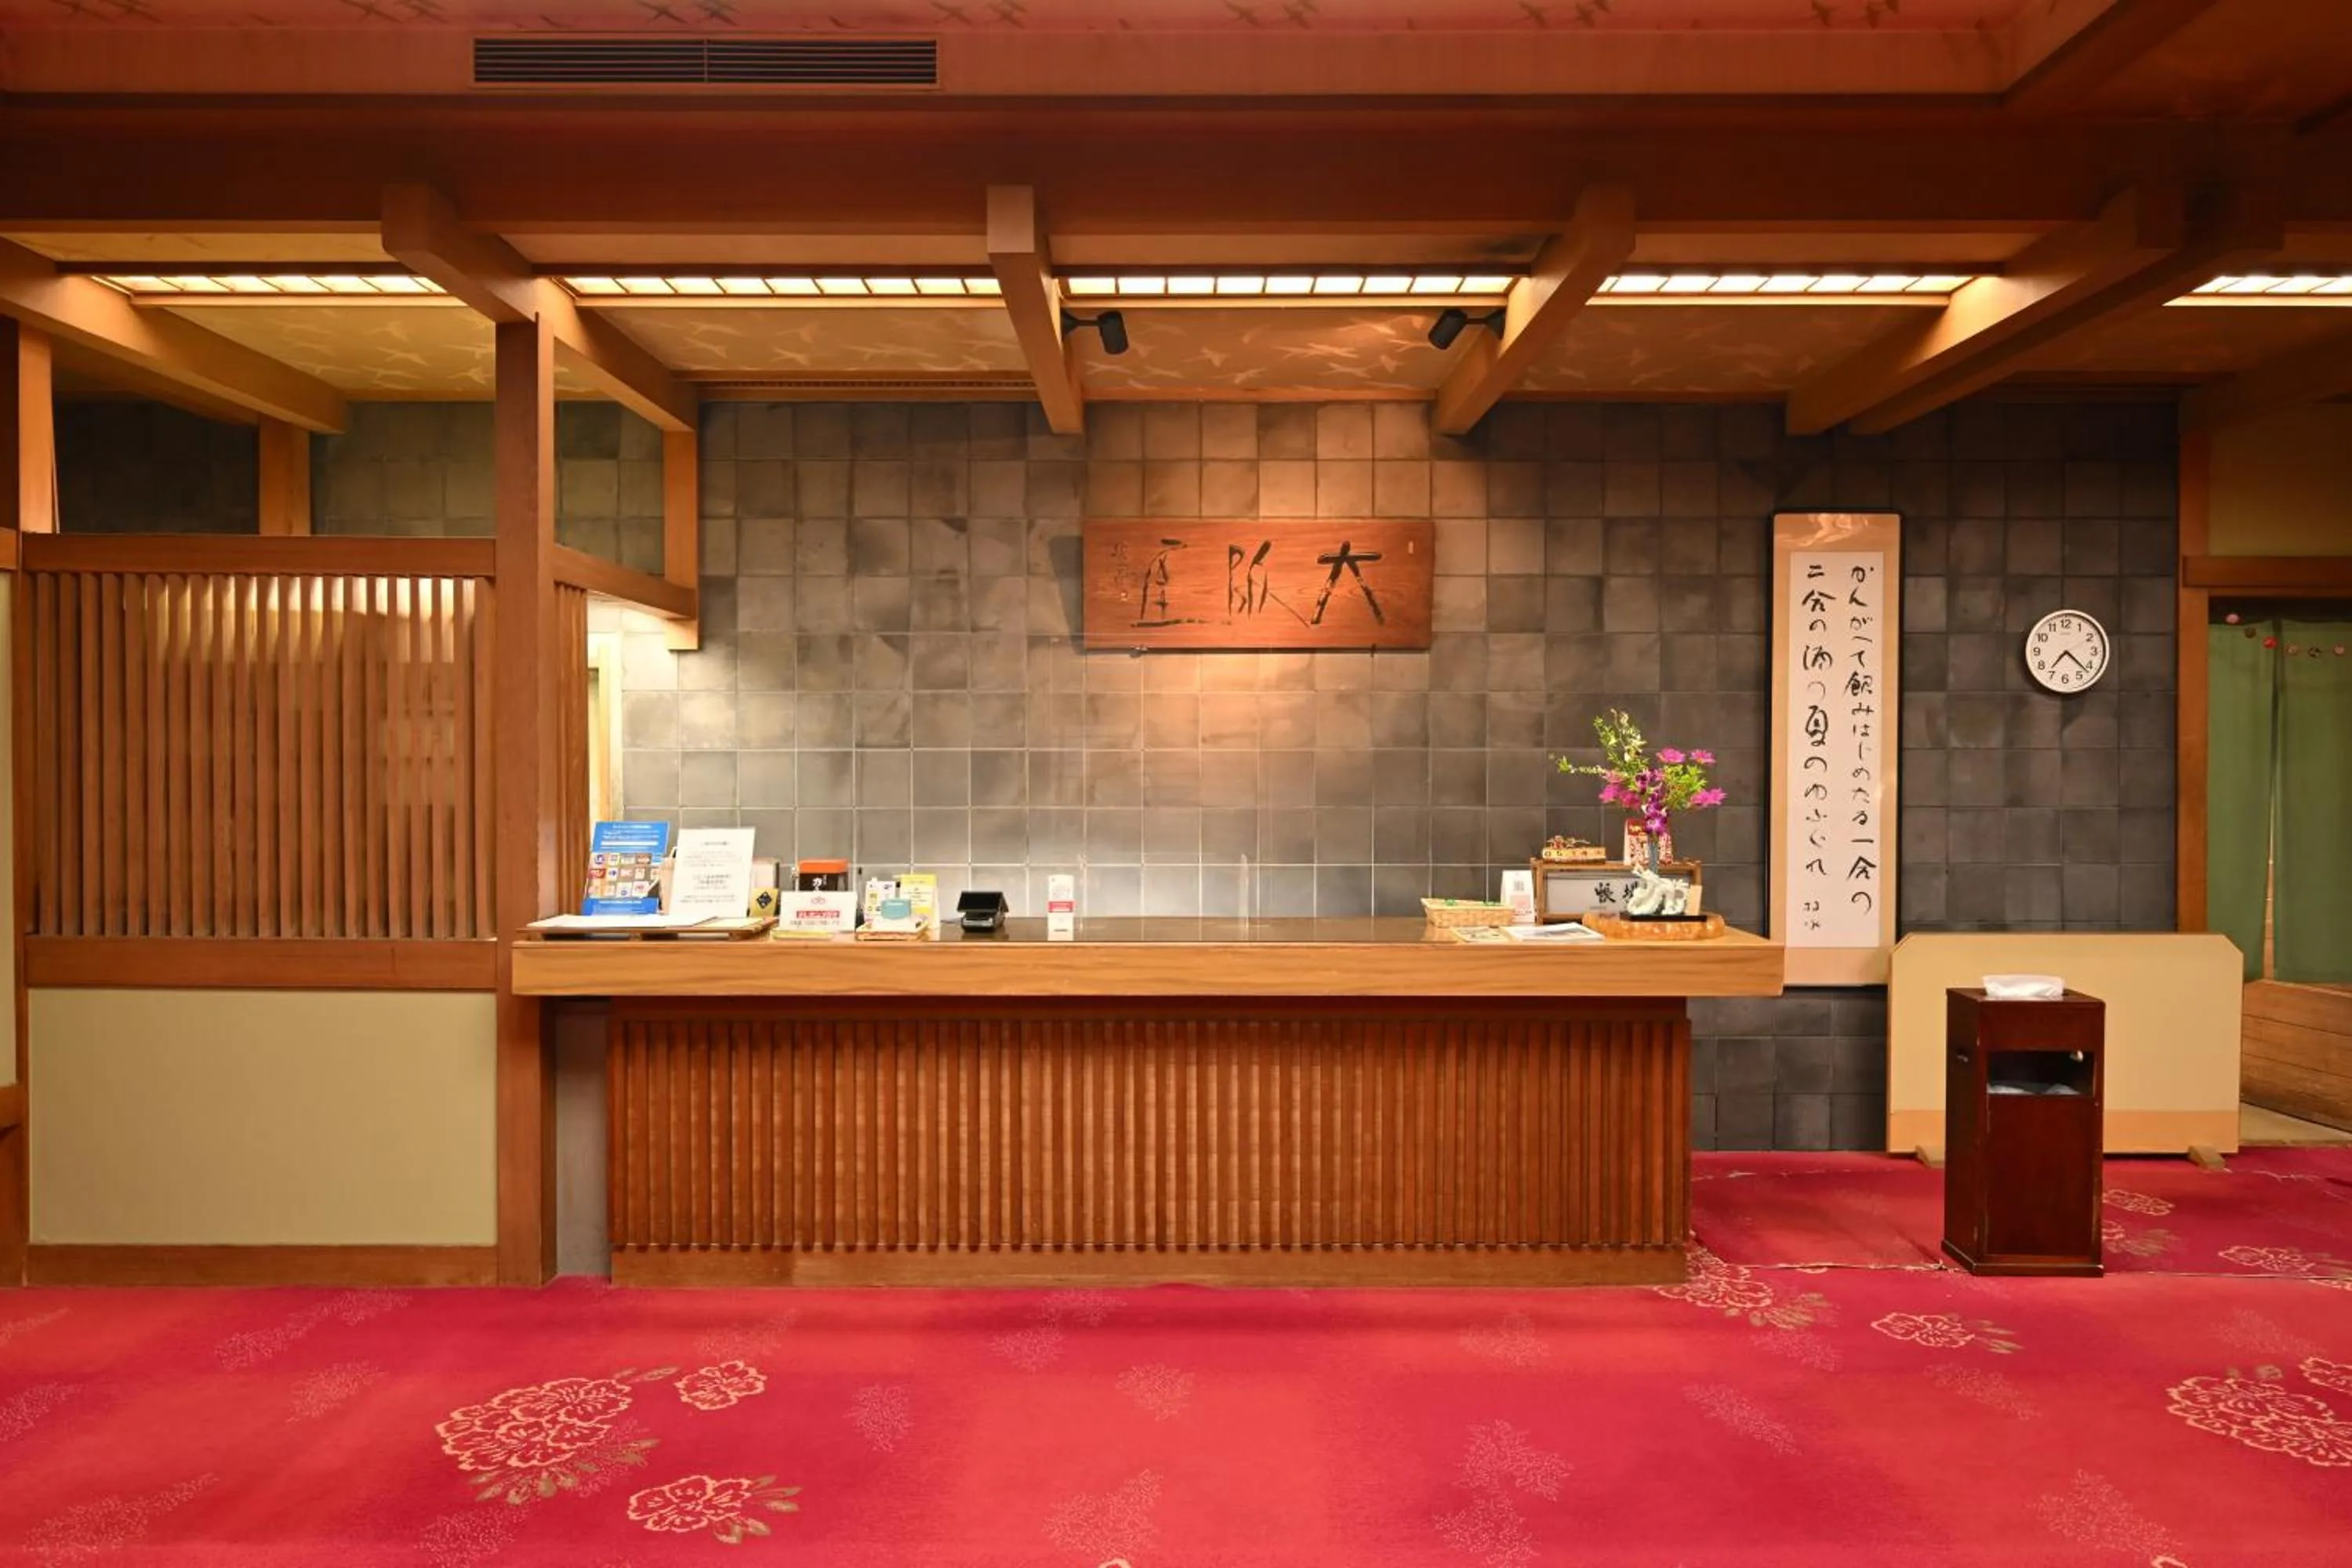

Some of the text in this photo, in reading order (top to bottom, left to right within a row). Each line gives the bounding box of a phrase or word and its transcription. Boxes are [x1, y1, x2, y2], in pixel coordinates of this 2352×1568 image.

[2048, 622, 2056, 632] 11
[2060, 619, 2071, 628] 12
[2076, 622, 2082, 632] 1
[2036, 633, 2049, 642] 10
[2085, 633, 2094, 642] 2
[2033, 647, 2041, 656] 9
[2090, 646, 2099, 656] 3
[2038, 660, 2045, 670] 8
[2085, 659, 2094, 670] 4
[2047, 670, 2056, 681] 7
[2061, 673, 2070, 684] 6
[2075, 670, 2083, 680] 5
